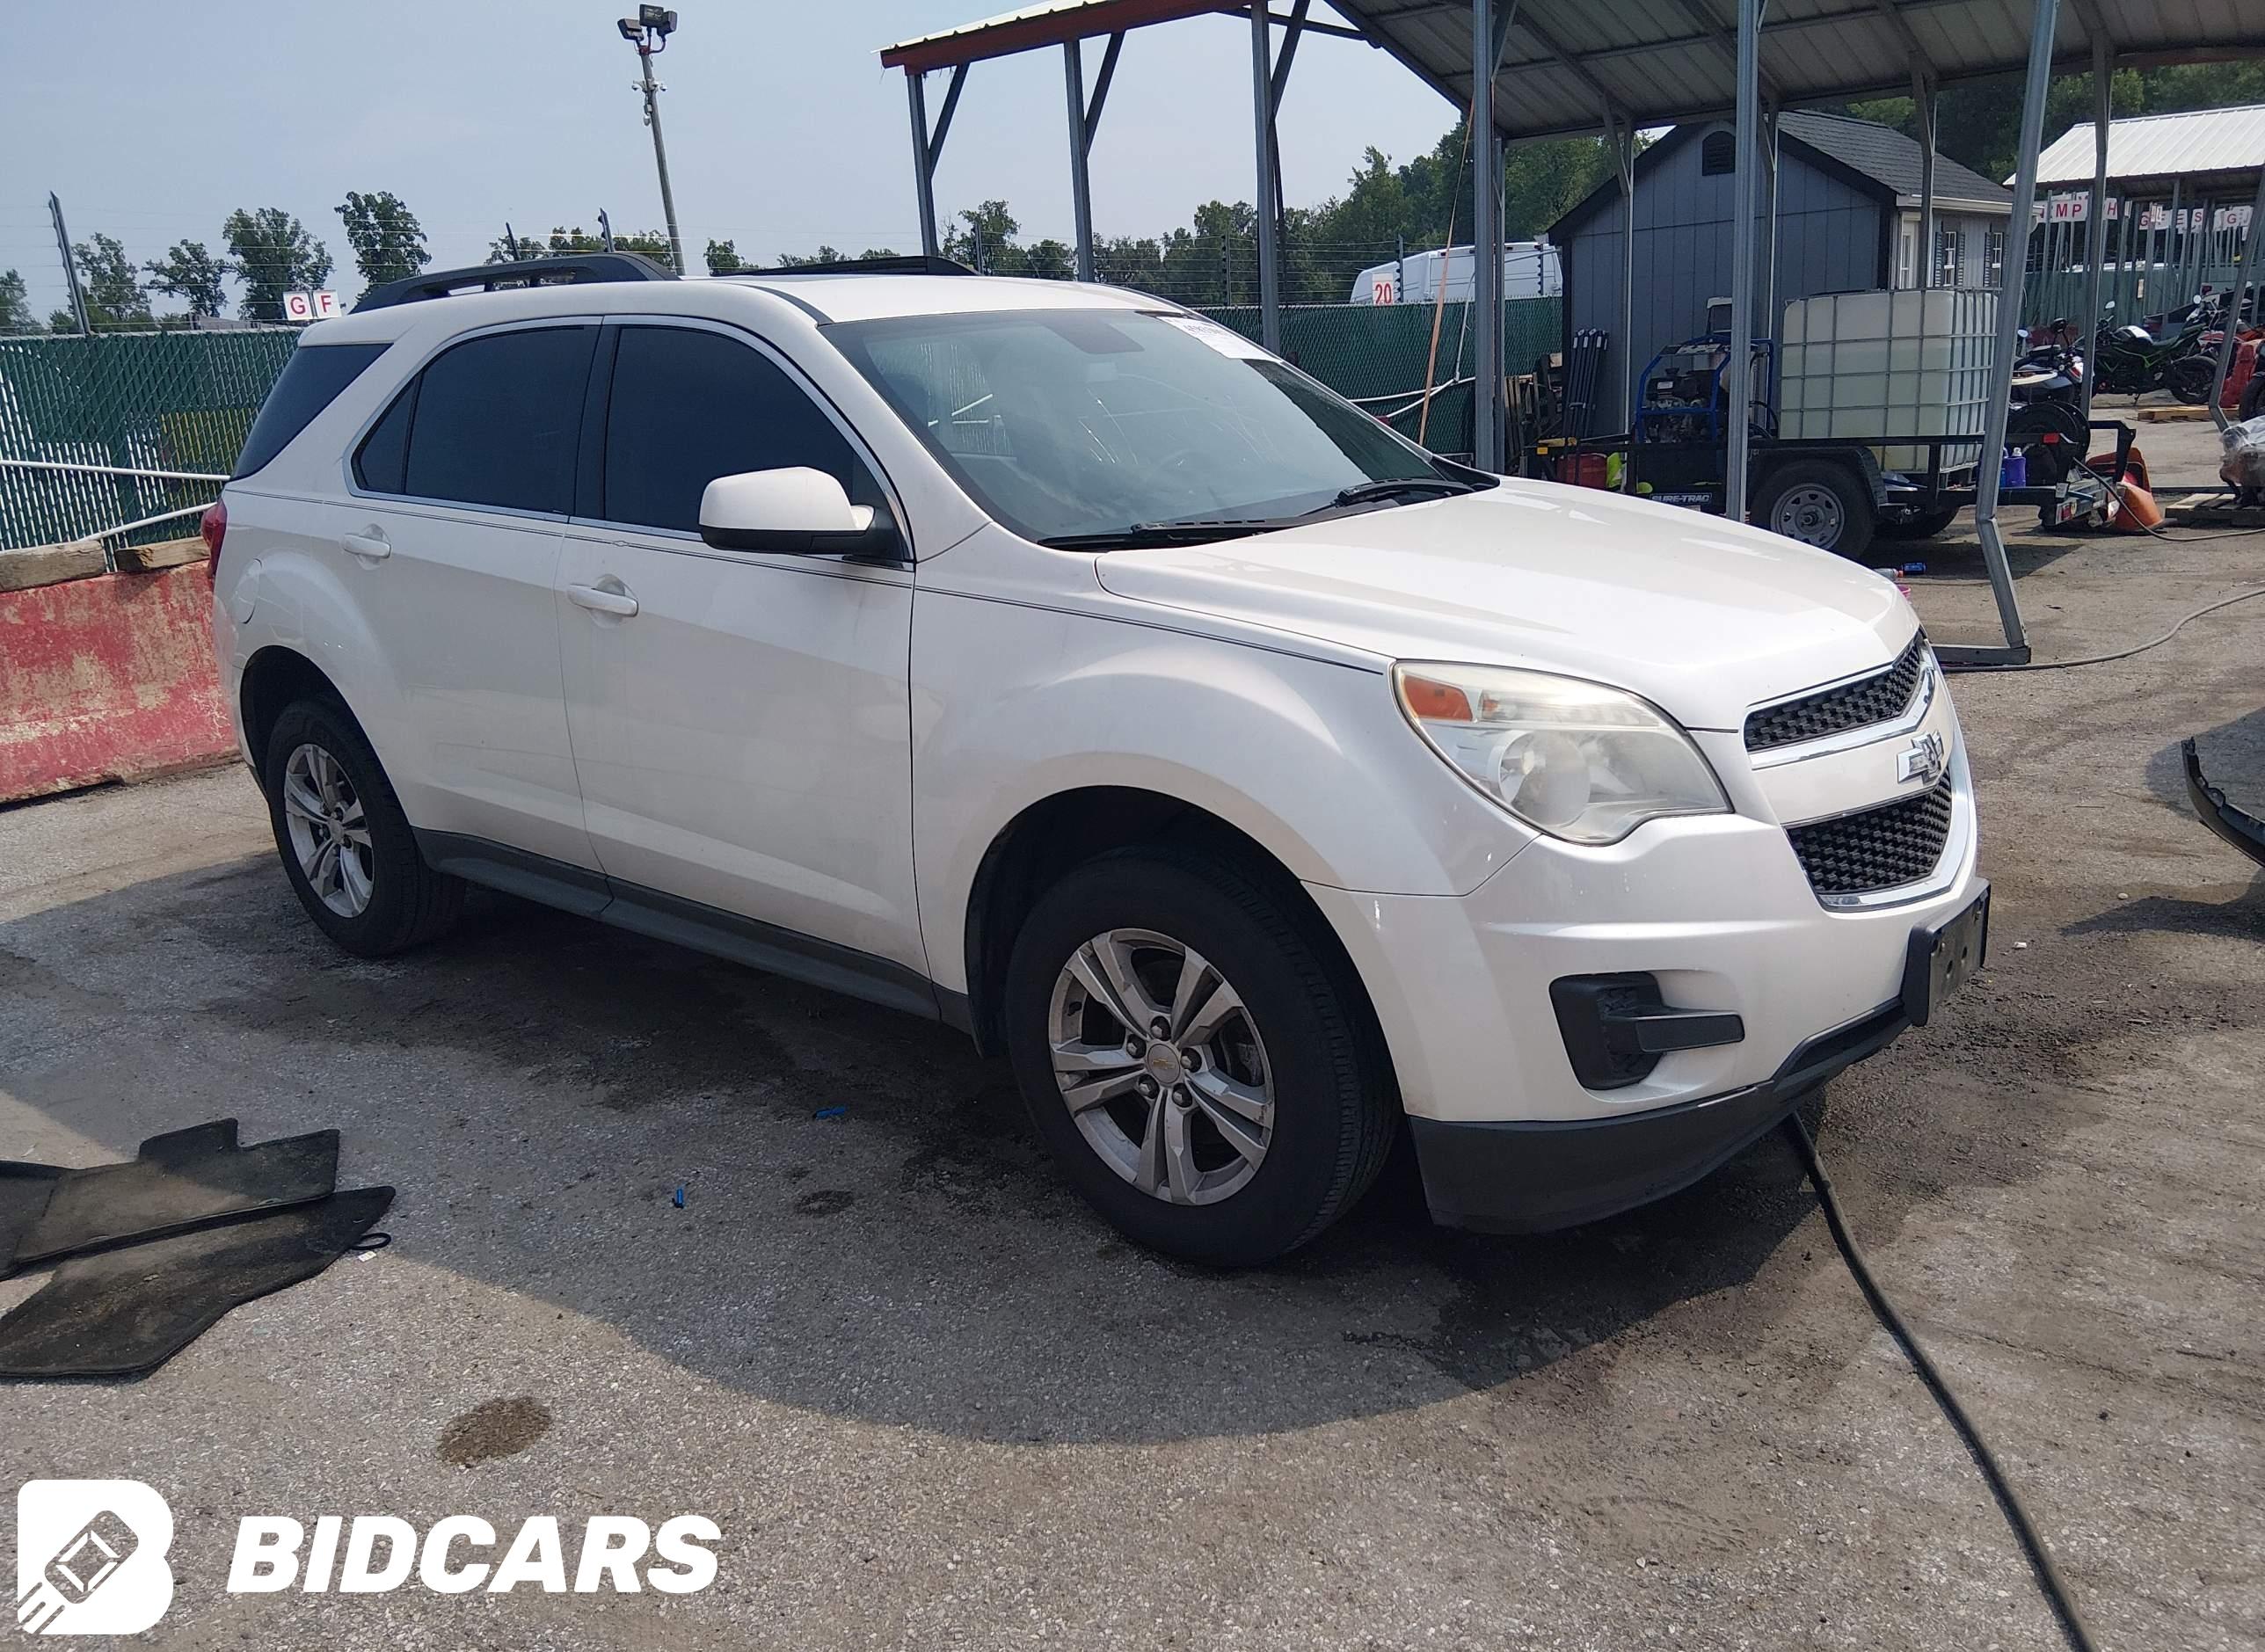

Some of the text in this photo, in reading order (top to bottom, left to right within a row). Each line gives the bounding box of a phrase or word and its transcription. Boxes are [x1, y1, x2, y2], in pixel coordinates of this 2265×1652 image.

[2056, 203, 2068, 218] M
[2072, 203, 2082, 218] P
[1375, 282, 1392, 304] 20
[289, 296, 307, 315] G
[320, 295, 332, 313] F
